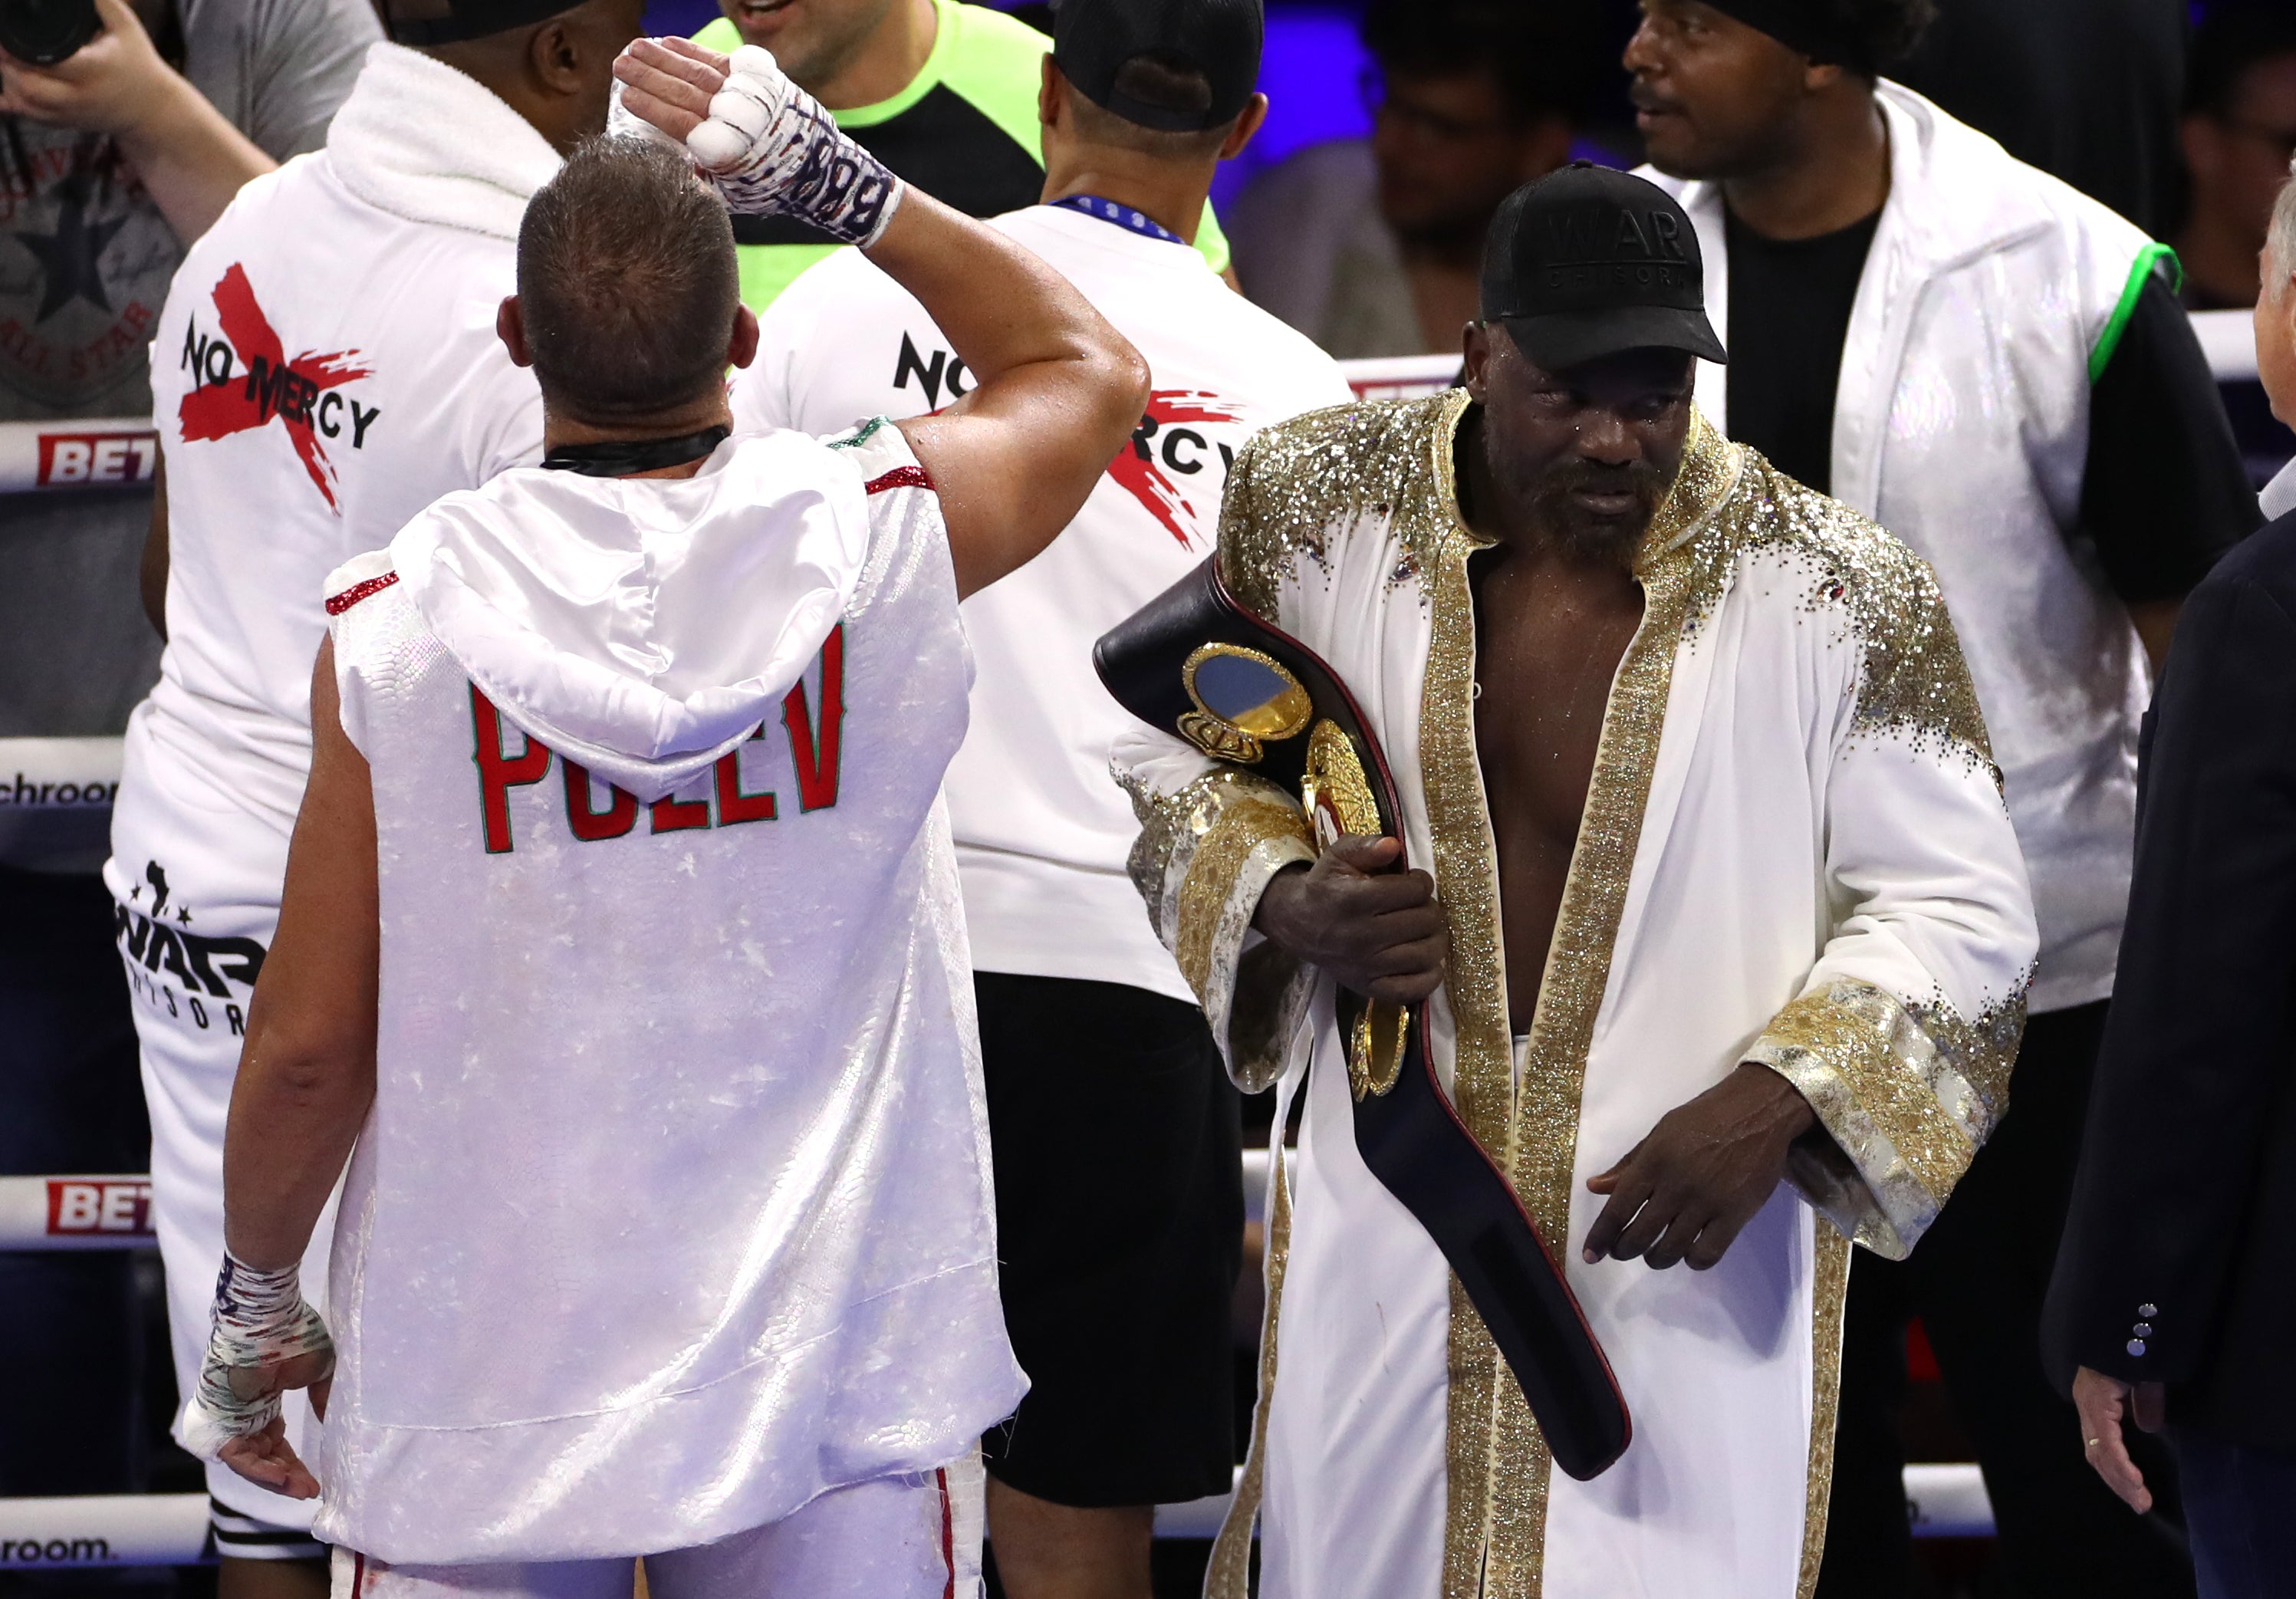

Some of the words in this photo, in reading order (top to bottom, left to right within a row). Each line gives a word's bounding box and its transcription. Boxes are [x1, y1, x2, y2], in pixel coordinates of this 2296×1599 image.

[1544, 207, 1685, 258] WAR
[181, 309, 233, 395] NO
[245, 354, 382, 449] MERCY
[469, 622, 847, 854] PEV
[117, 903, 268, 999] WAR
